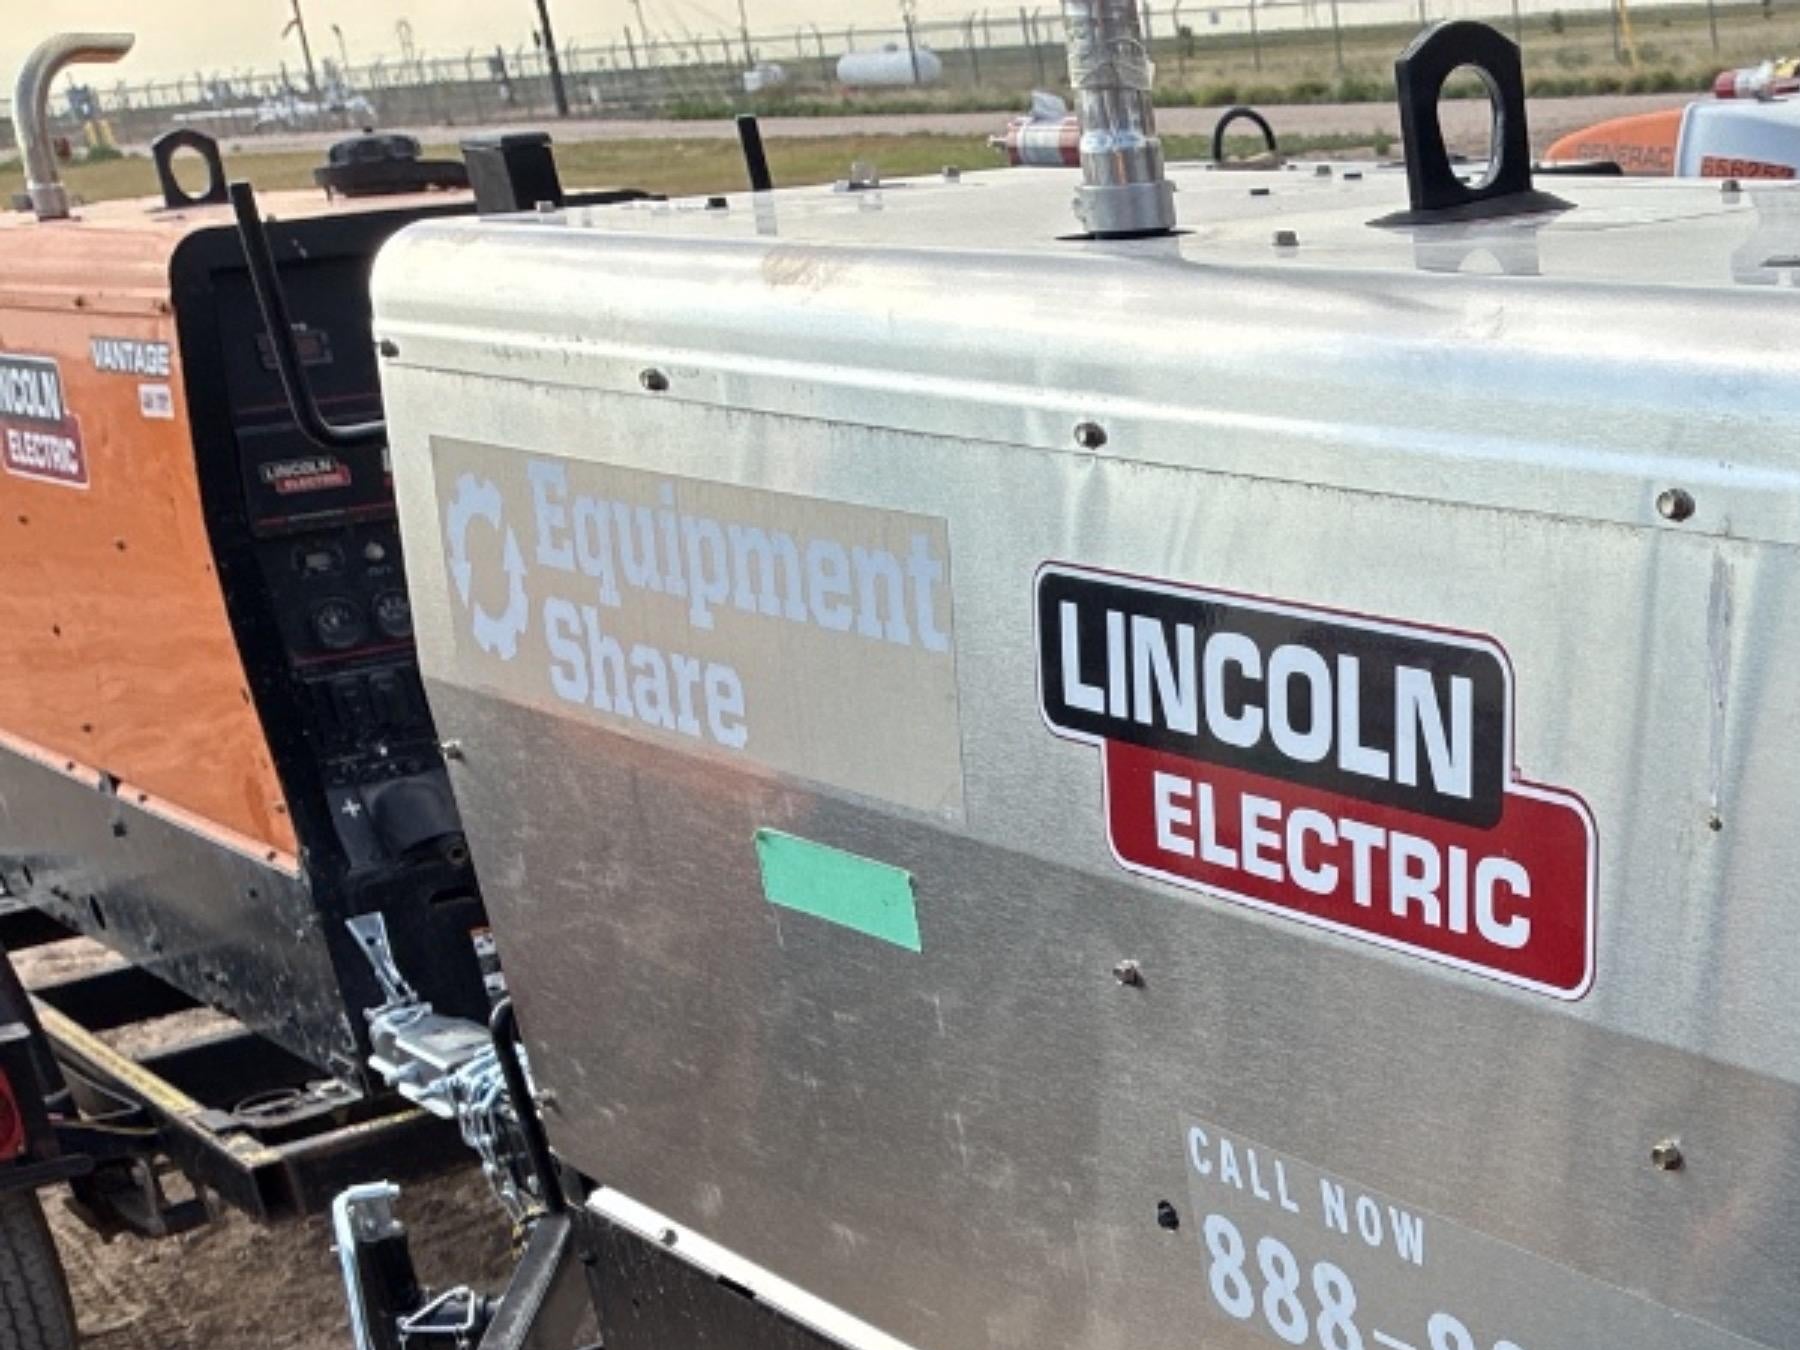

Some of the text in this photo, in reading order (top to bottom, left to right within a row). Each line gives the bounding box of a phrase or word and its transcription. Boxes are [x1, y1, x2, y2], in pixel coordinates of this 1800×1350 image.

[91, 338, 170, 377] VANTAGE
[7, 427, 79, 475] ELECTRIC
[527, 457, 951, 655] Equipment
[543, 594, 748, 750] Share
[1059, 600, 1473, 800] LINCOLN
[1153, 770, 1532, 950] ELECTRIC
[1188, 1125, 1426, 1268] CALL NOW
